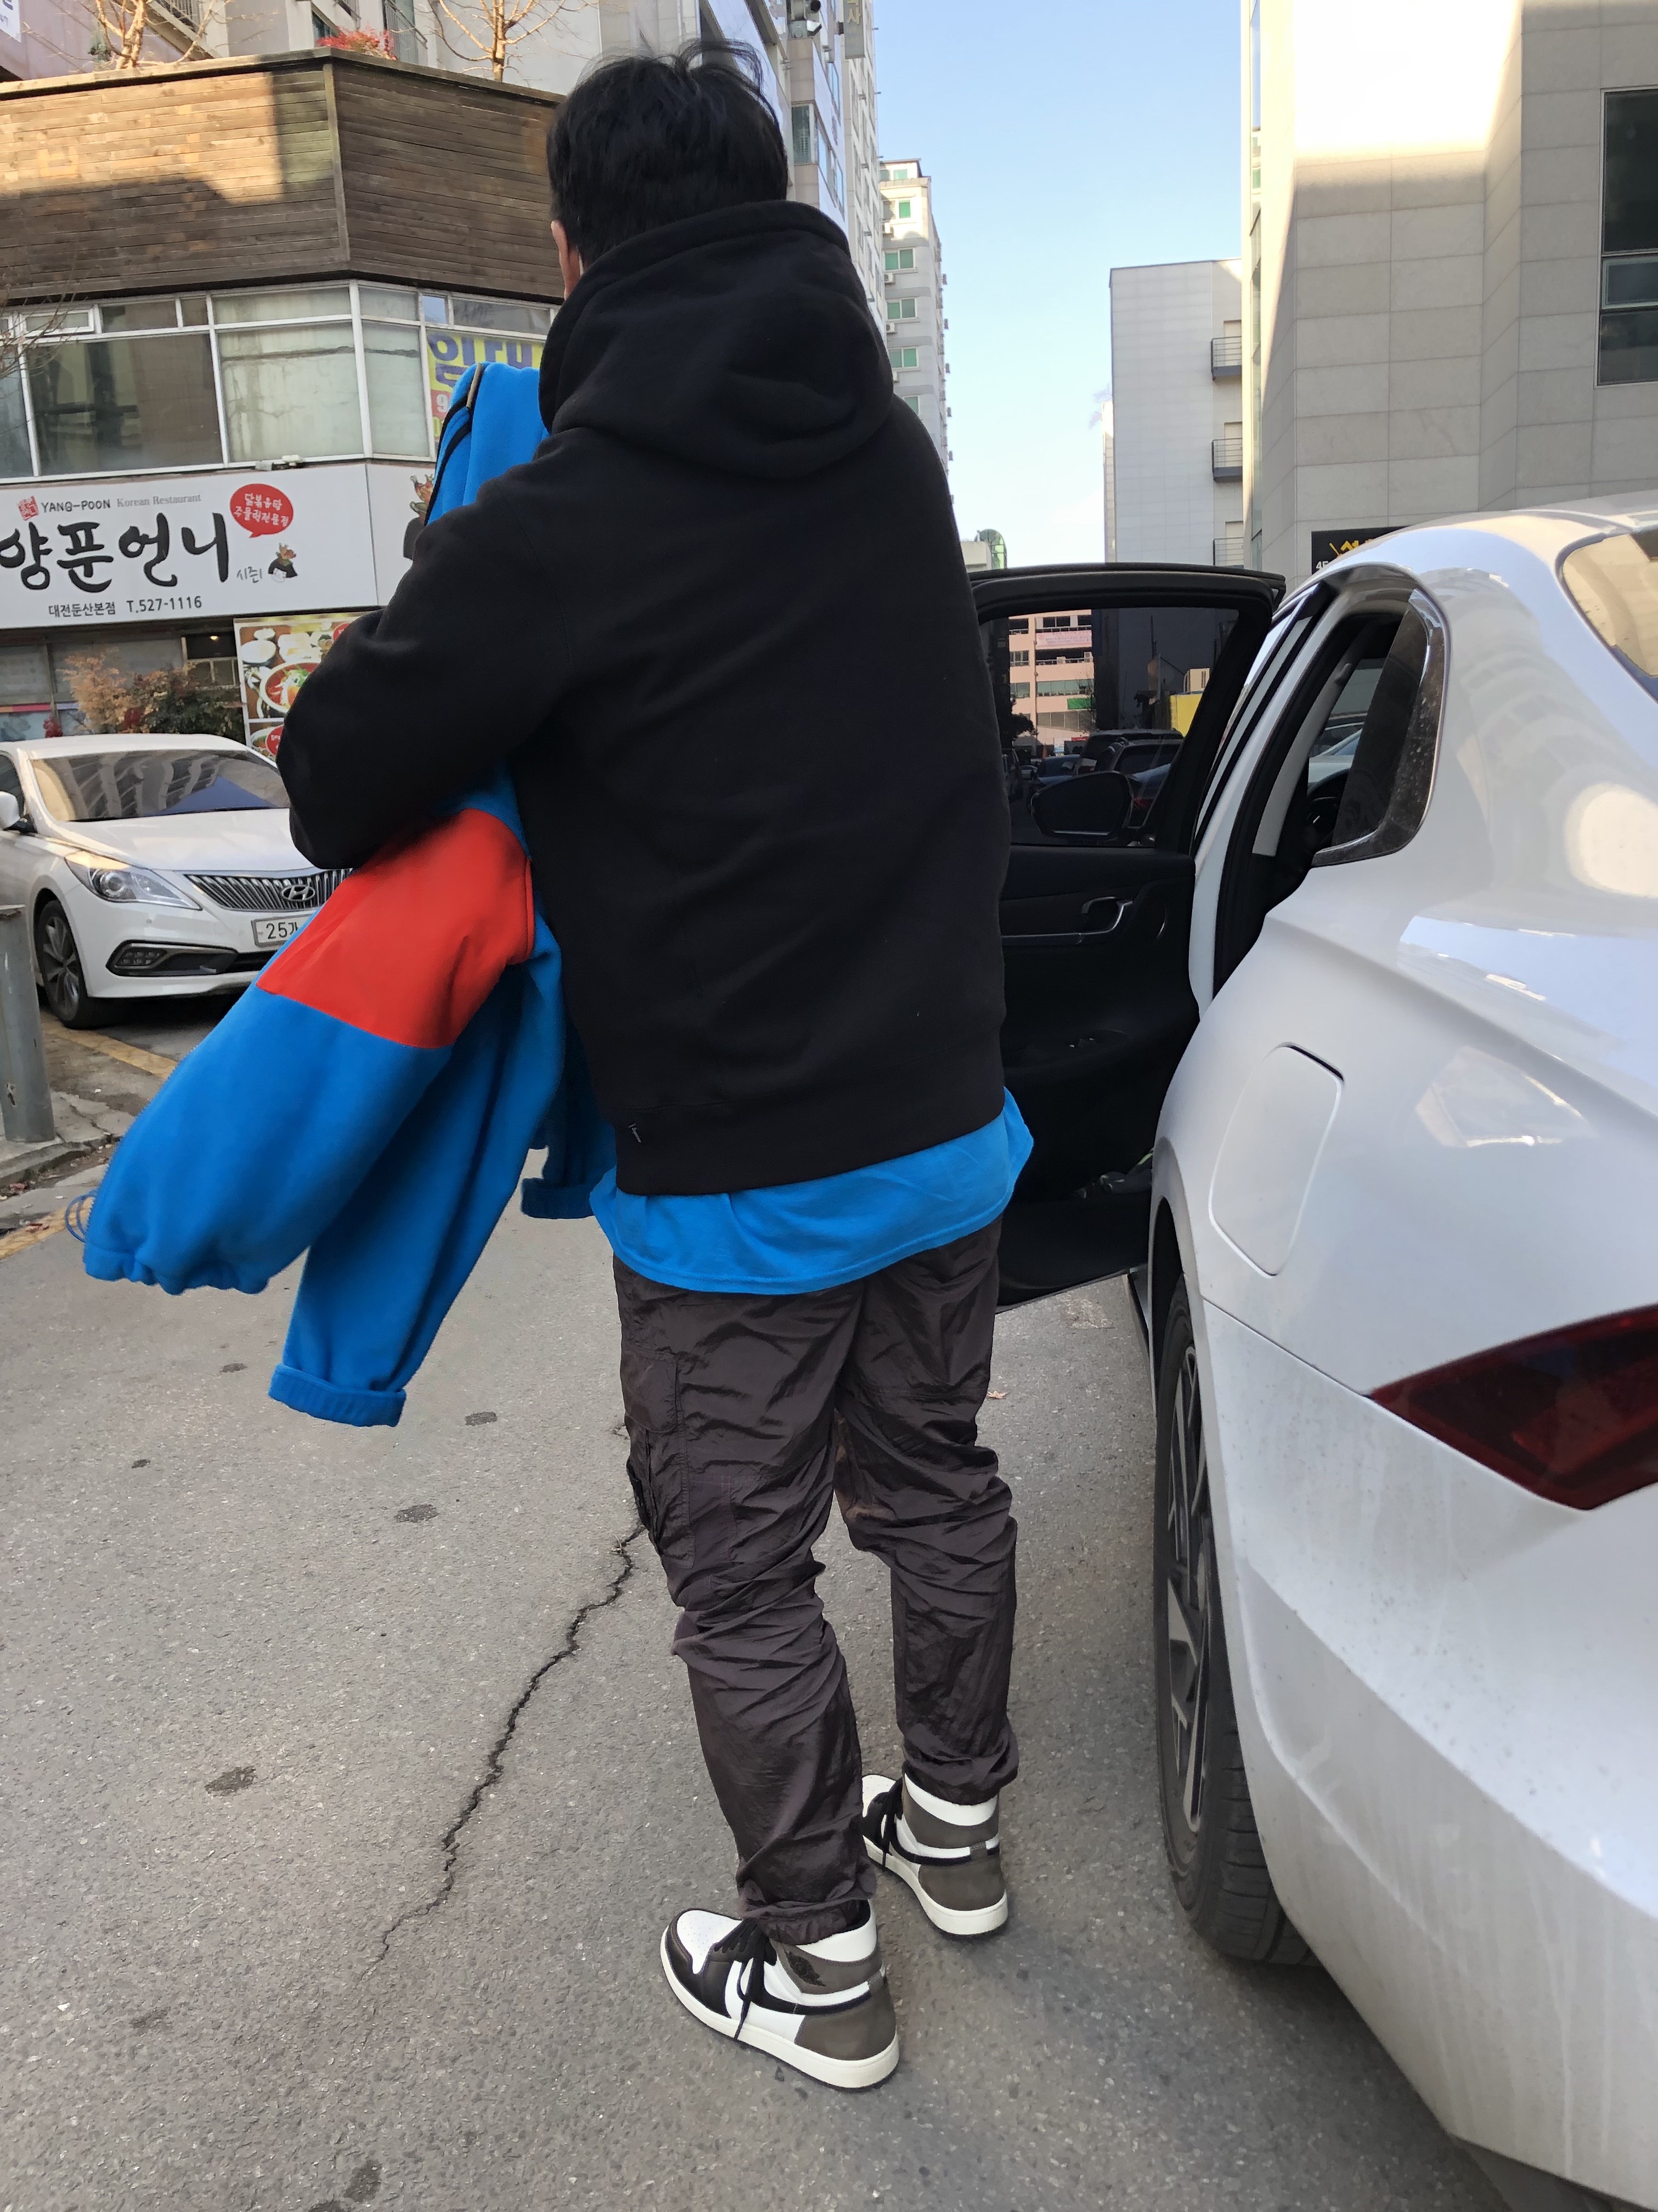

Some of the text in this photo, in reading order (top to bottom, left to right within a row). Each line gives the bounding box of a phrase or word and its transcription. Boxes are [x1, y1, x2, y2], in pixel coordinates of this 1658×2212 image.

[41, 499, 111, 513] YANG-POON
[116, 498, 150, 507] Korean
[153, 494, 201, 505] Restaurant
[233, 506, 289, 527] 주물럭전문점
[0, 512, 229, 593] 양푼언니
[48, 596, 202, 618] 대전둔산본점 T.527-1116
